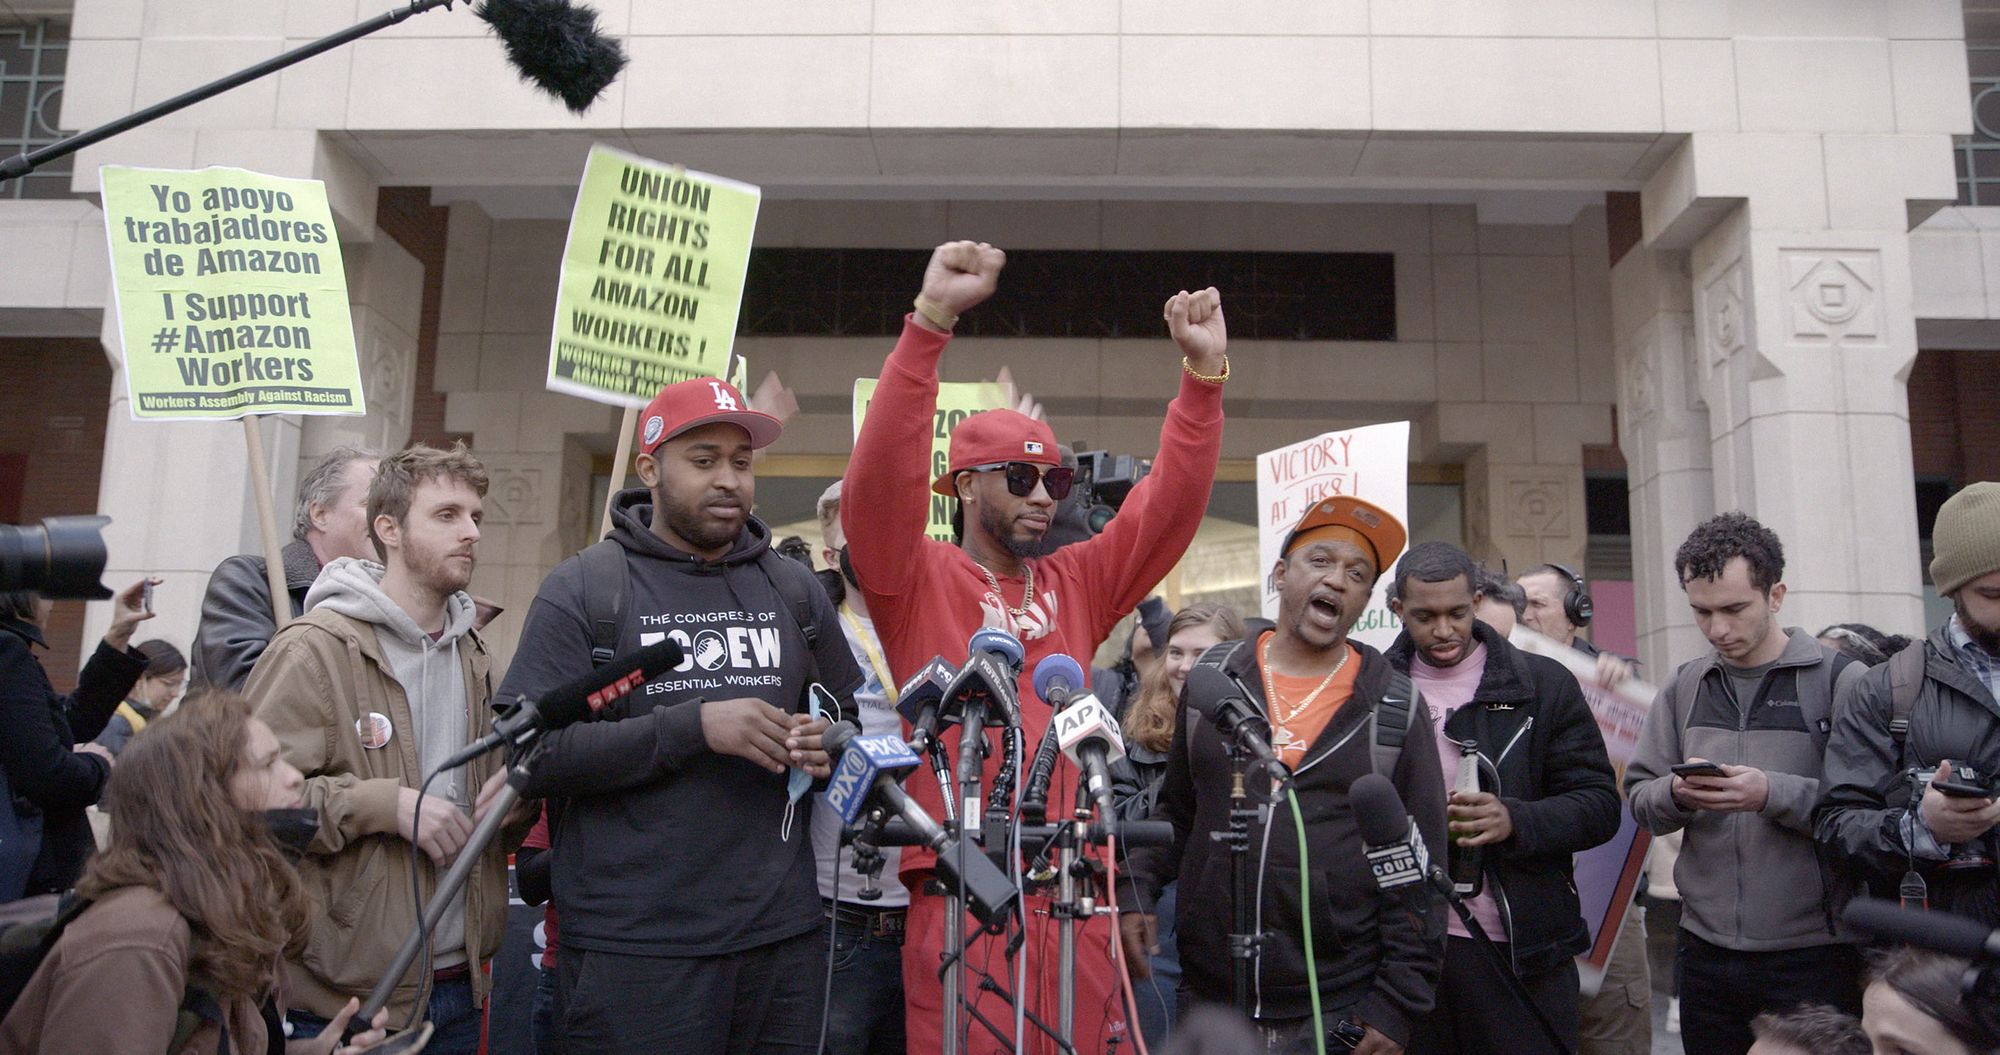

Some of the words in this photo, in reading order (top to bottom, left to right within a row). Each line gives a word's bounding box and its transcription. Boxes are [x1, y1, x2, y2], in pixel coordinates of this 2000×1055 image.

[150, 184, 190, 213] Yo
[202, 186, 294, 214] apoyo
[620, 165, 711, 212] UNION
[124, 214, 328, 245] trabajadores
[607, 202, 710, 251] RIGHTS
[144, 248, 184, 276] de
[196, 248, 321, 276] Amazon
[598, 238, 656, 276] FOR
[663, 254, 711, 290] ALL
[163, 293, 175, 320] I
[186, 292, 311, 321] Support
[591, 276, 699, 322] AMAZON
[151, 325, 311, 354] #Amazon
[572, 309, 691, 358] WORKERS
[176, 352, 314, 386] Workers
[143, 395, 195, 409] Workers
[200, 391, 255, 409] Assembly
[258, 390, 301, 404] Against
[305, 390, 347, 404] Racism
[709, 382, 738, 411] LA
[1270, 434, 1353, 484] VICTORY
[1270, 497, 1289, 526] AT
[640, 613, 671, 626] THE
[674, 611, 755, 624] CONGRESS
[758, 612, 776, 622] OF
[646, 678, 722, 695] ESSENTIAL
[725, 675, 782, 687] WORKERS
[1061, 705, 1094, 737] AP
[1372, 857, 1415, 876] COUP
